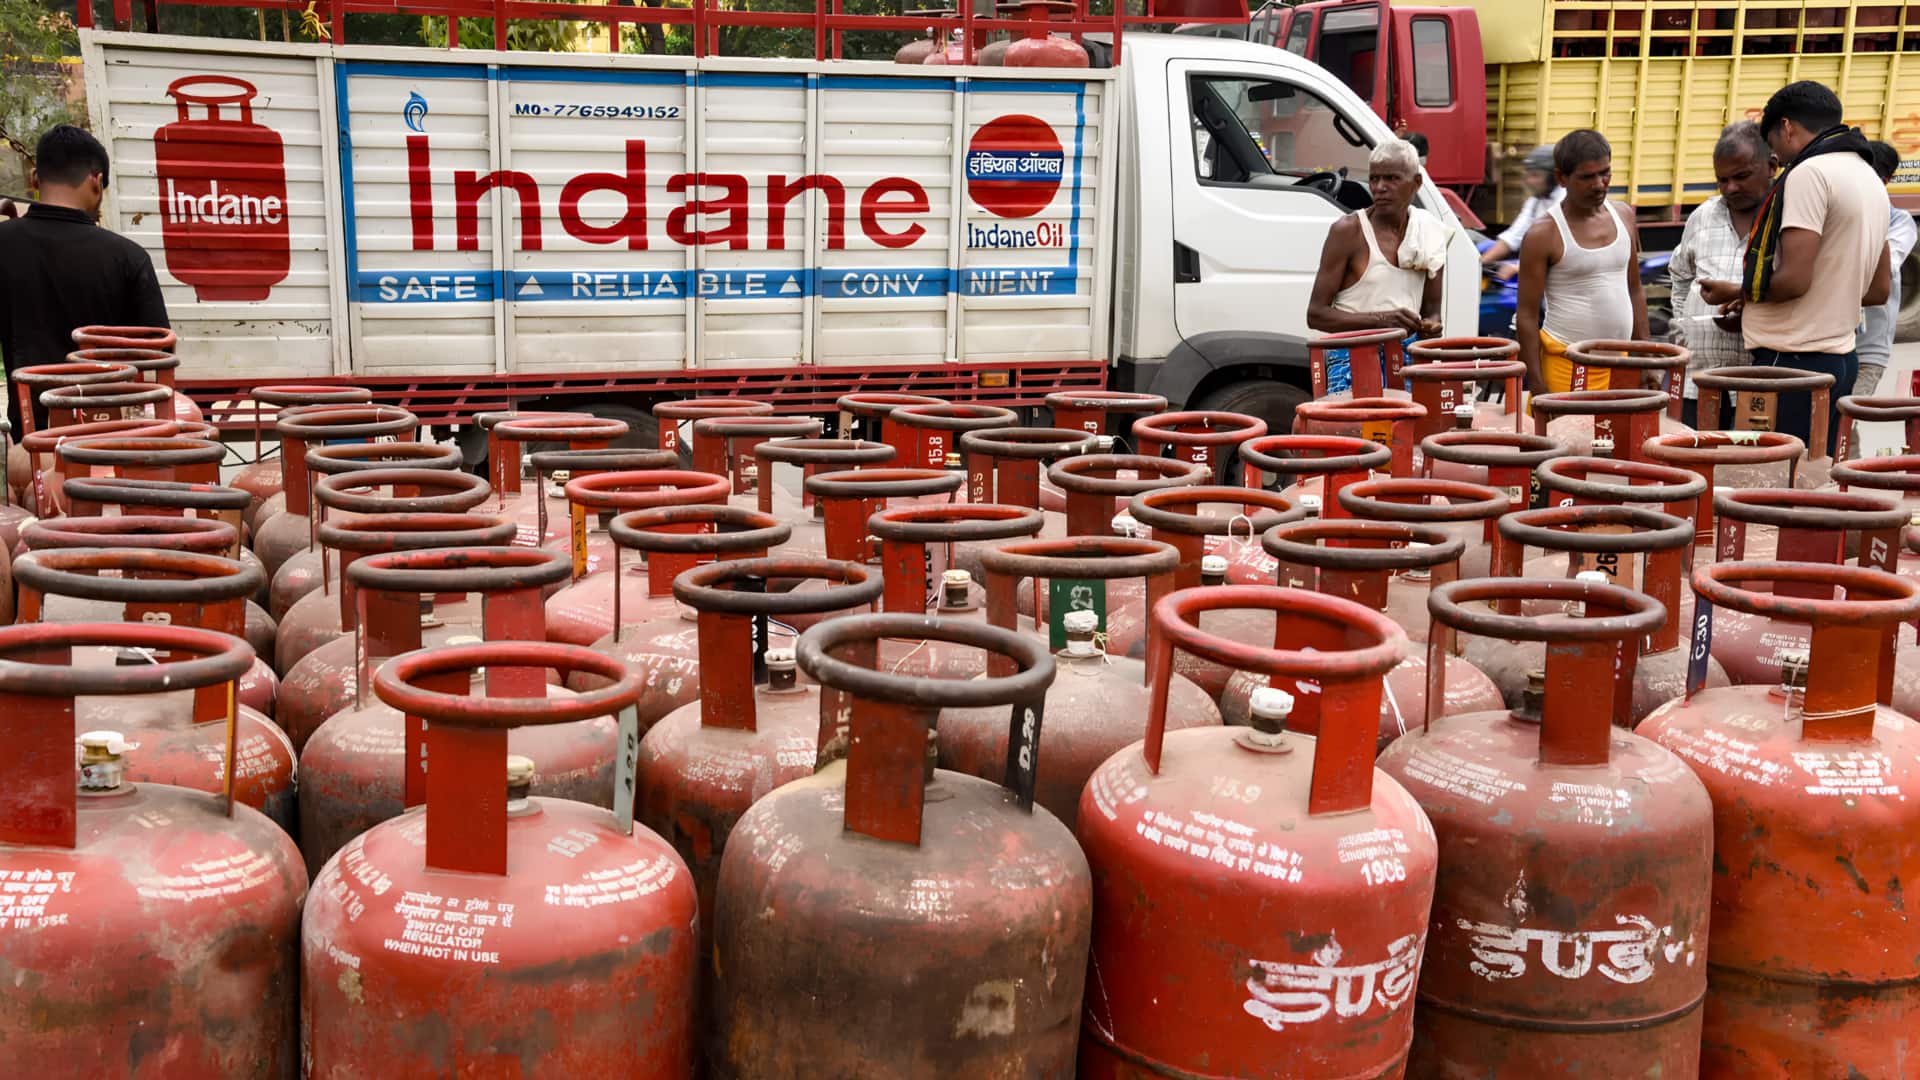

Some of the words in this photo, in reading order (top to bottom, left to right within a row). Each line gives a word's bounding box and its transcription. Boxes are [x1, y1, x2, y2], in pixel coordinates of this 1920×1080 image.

[970, 152, 1017, 176] इंडियन
[1018, 152, 1062, 174] ऑयल
[166, 178, 282, 225] Indane
[406, 134, 931, 251] Indane
[378, 275, 478, 301] SAFE
[928, 436, 943, 465] 15.8
[1360, 857, 1407, 887] 1906
[401, 929, 484, 949] REGULATOR
[405, 919, 456, 936] SWITCH
[383, 938, 422, 955] WHEN
[421, 944, 452, 960] NOT
[453, 949, 469, 961] IN
